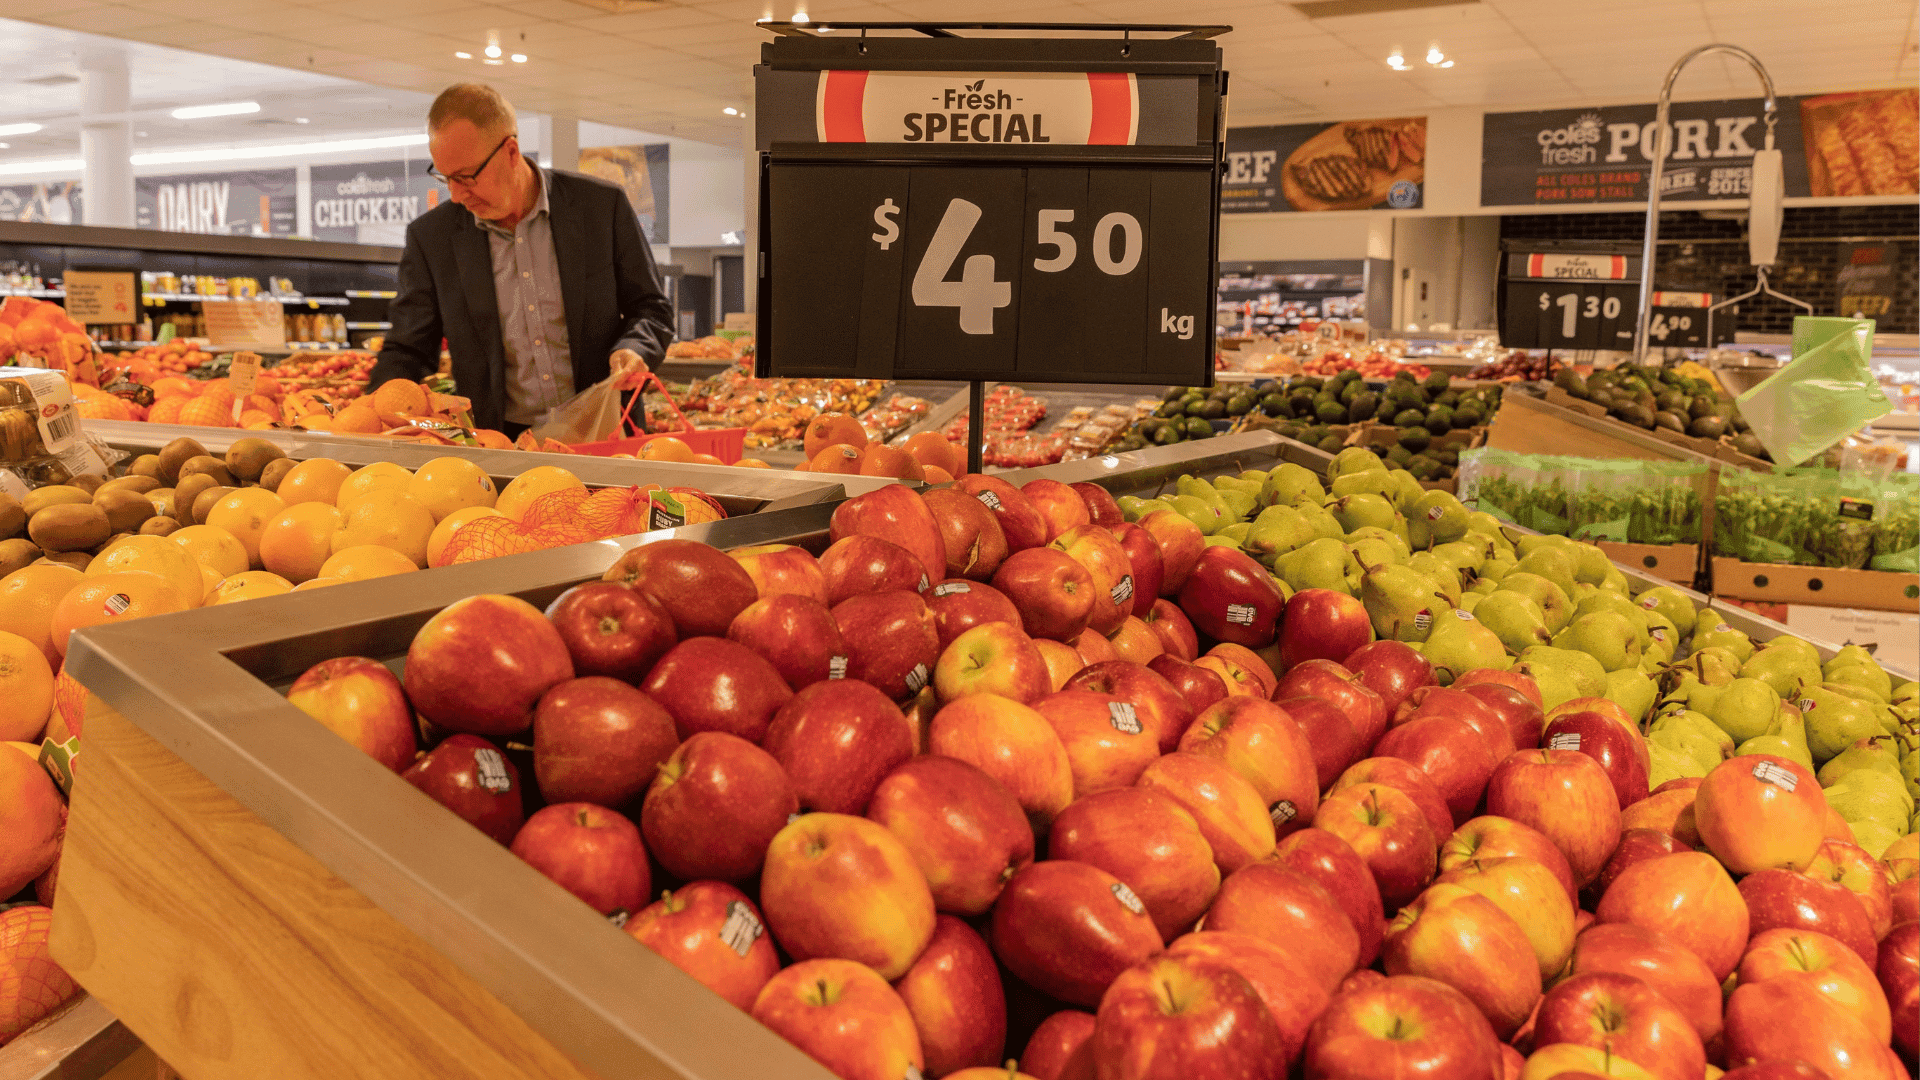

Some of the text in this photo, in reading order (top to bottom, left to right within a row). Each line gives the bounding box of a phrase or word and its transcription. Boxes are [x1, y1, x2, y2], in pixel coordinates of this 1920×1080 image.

[903, 112, 1050, 143] SPECIAL
[1537, 124, 1600, 145] coles
[1605, 116, 1757, 163] PORK
[1541, 144, 1596, 165] fresh
[158, 181, 230, 233] DAIRY
[314, 195, 419, 228] CHICKEN
[872, 198, 1143, 335] $ 4 50
[1554, 266, 1599, 278] SPECIAL
[1160, 307, 1195, 340] kg
[1538, 292, 1621, 338] $ 1 30
